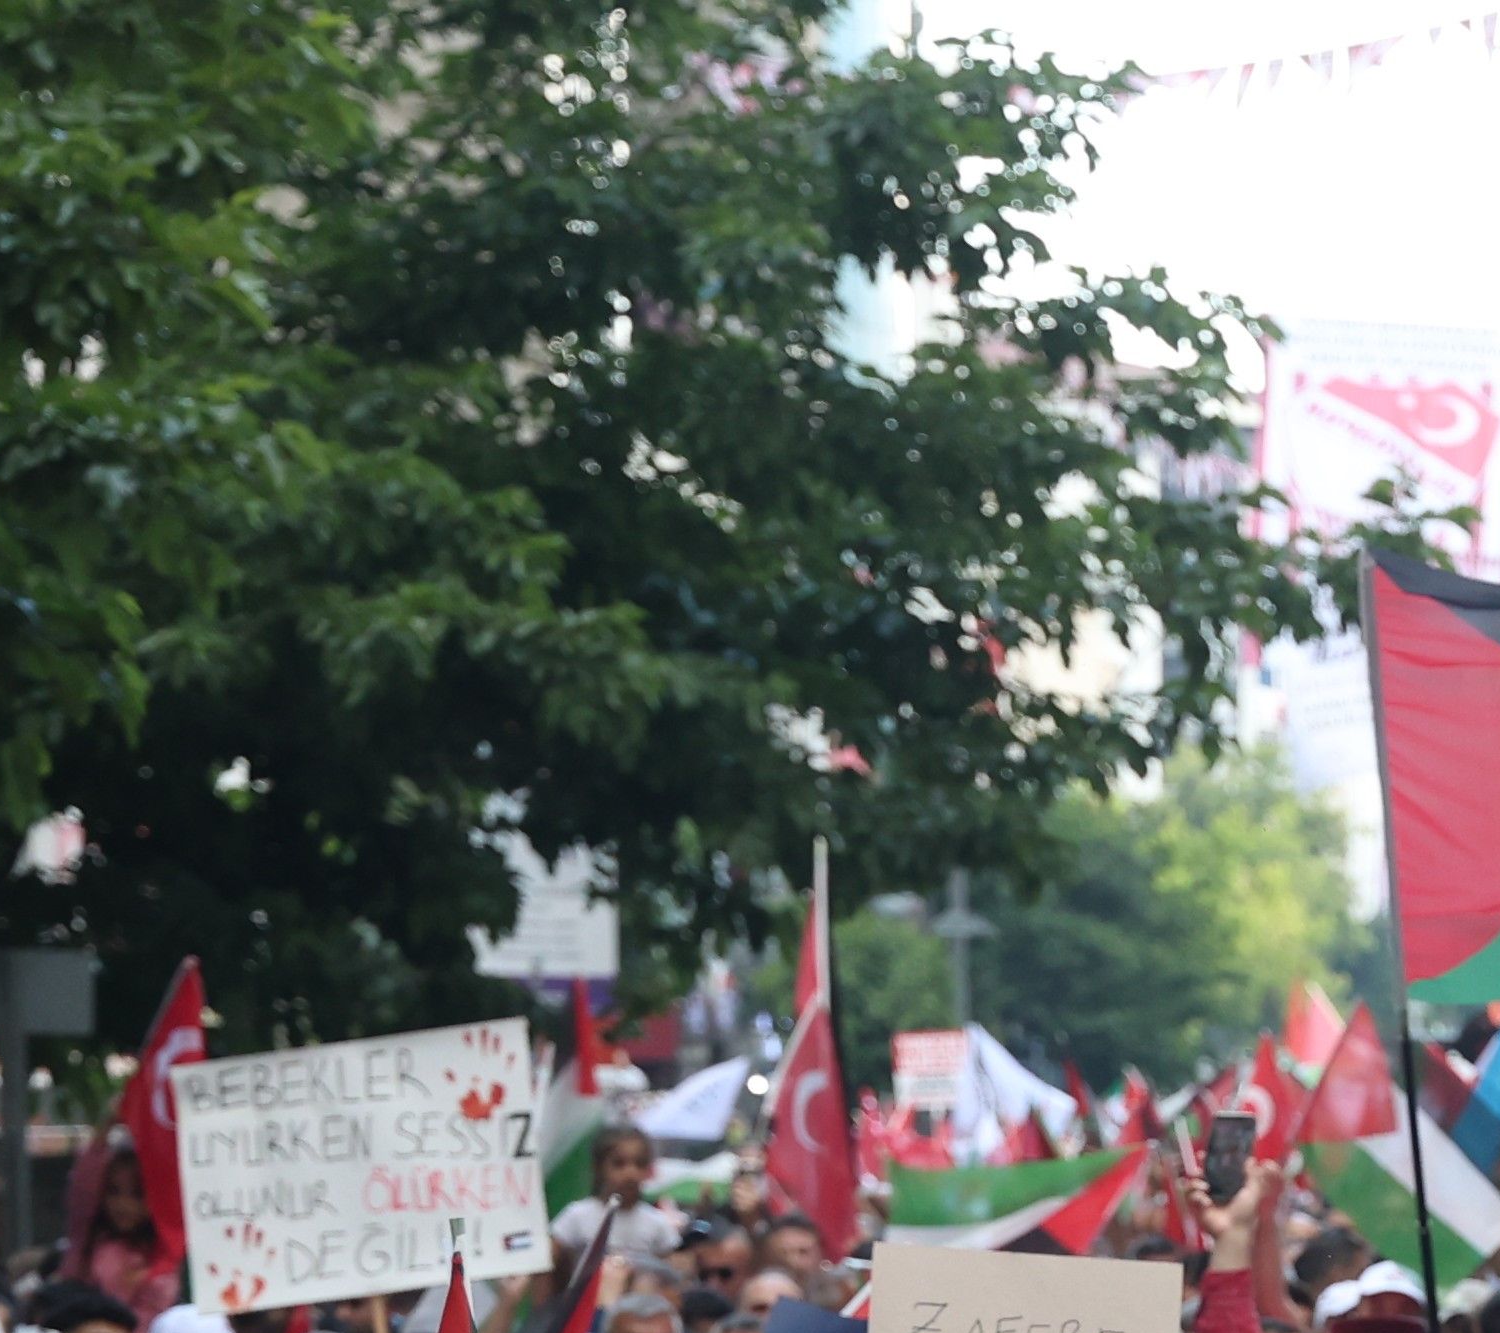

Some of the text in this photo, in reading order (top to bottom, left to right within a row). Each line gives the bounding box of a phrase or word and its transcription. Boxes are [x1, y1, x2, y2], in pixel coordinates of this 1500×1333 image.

[184, 1047, 432, 1112] BEBEKLER
[187, 1112, 372, 1167] UYURKEN
[362, 1163, 533, 1213] ÖLÜRKEN
